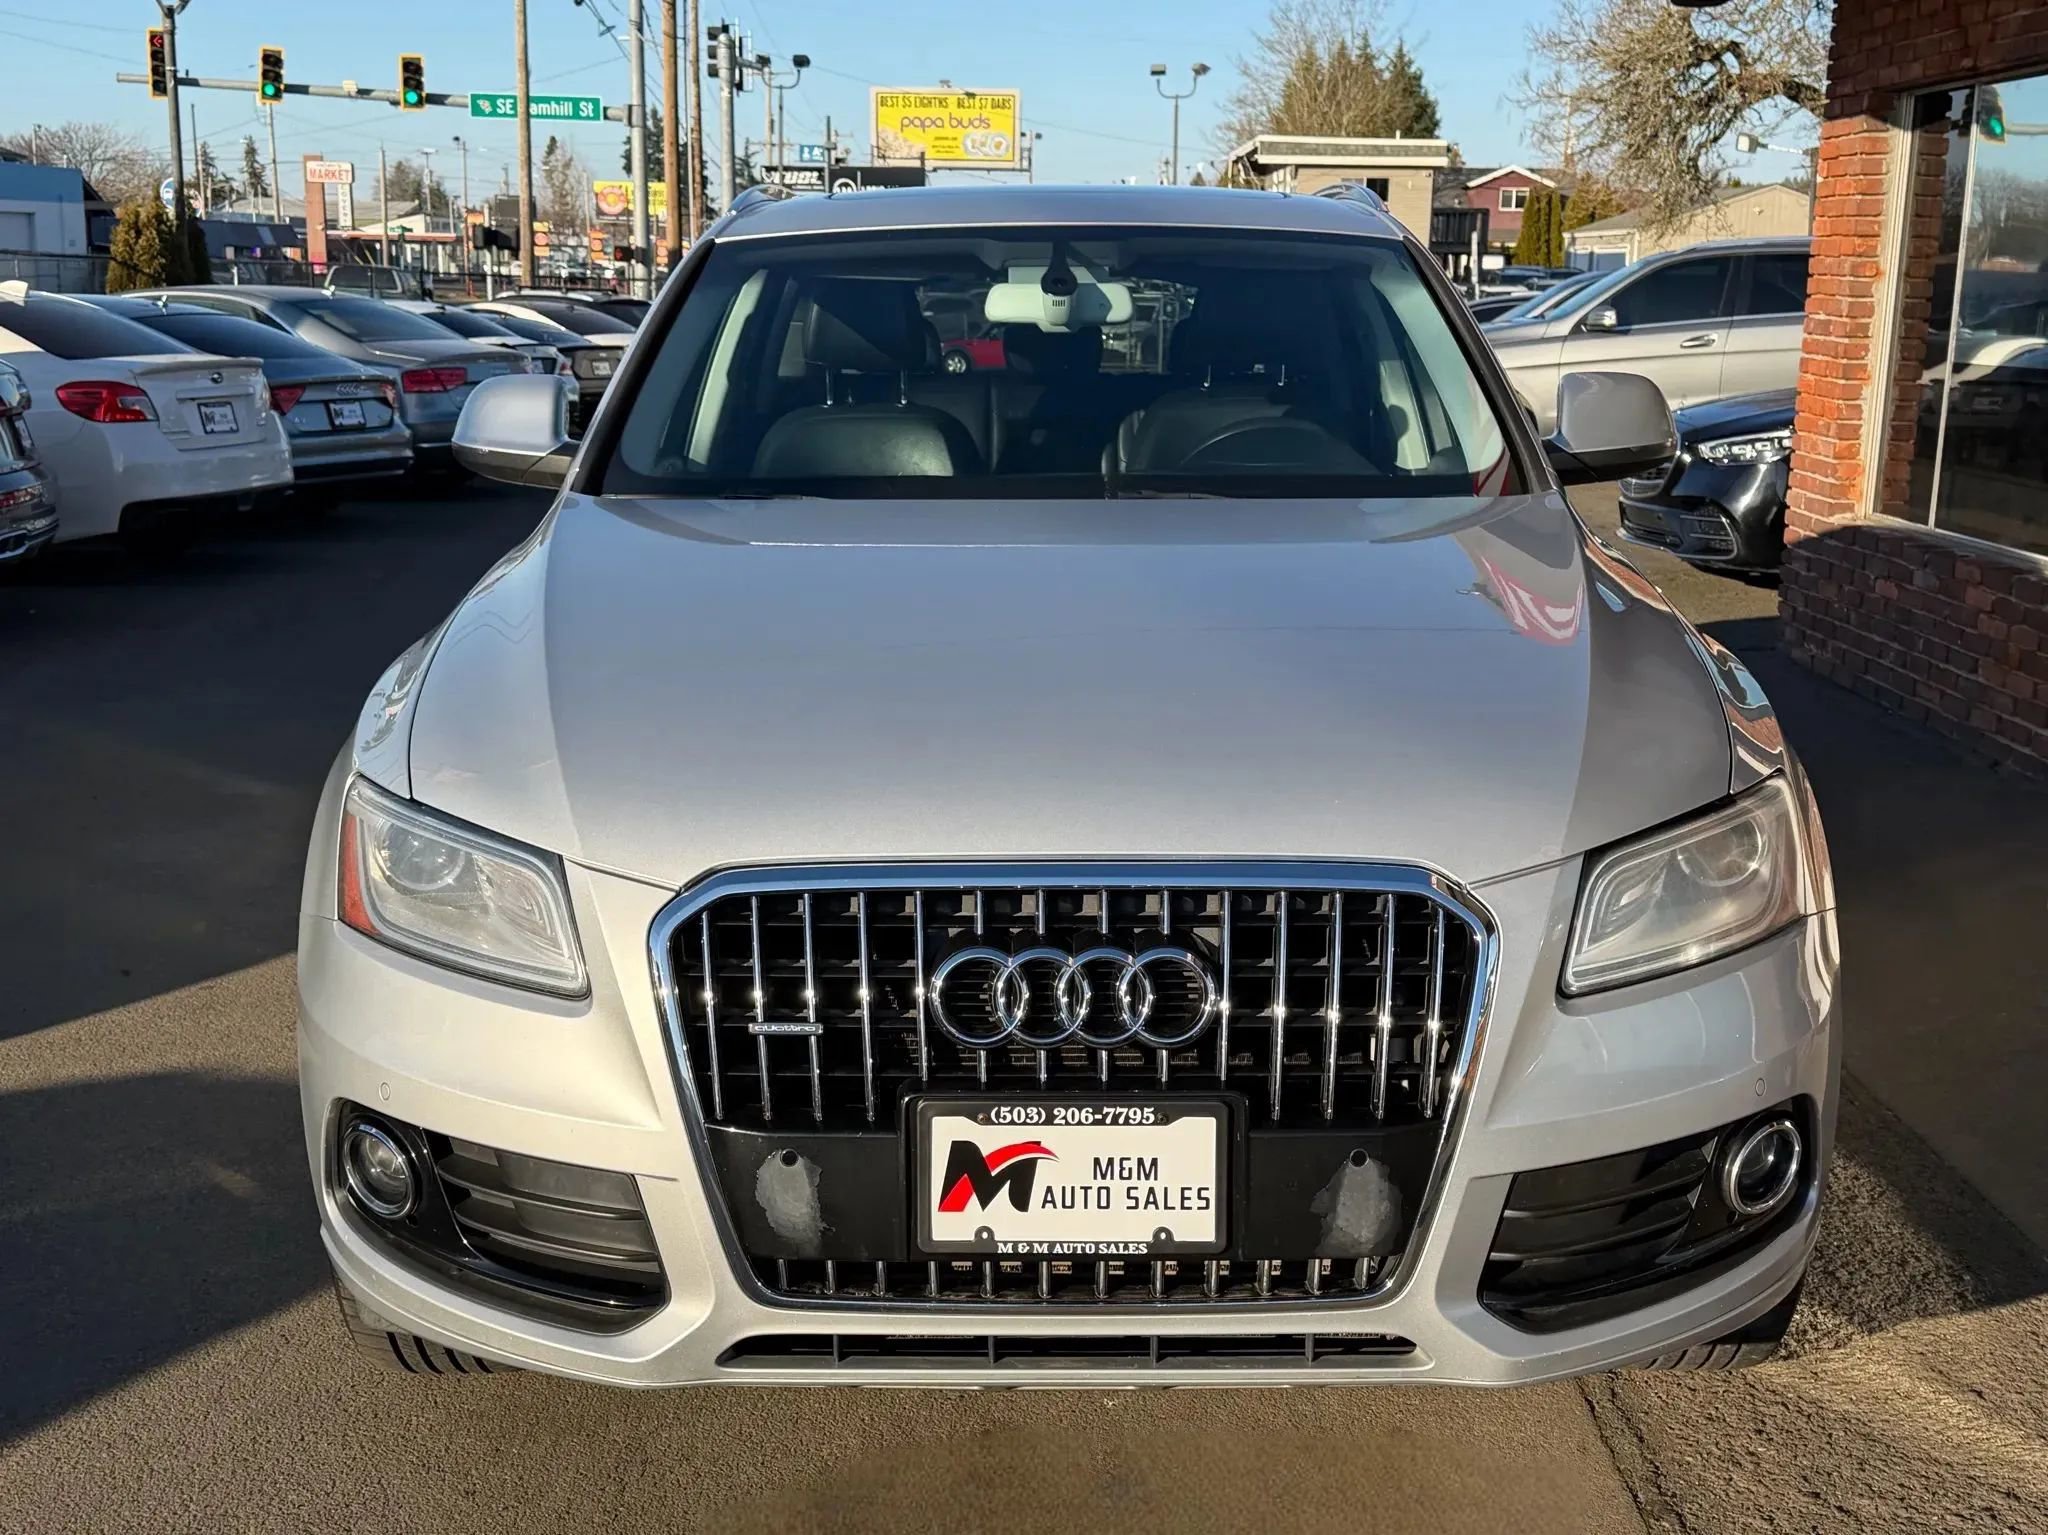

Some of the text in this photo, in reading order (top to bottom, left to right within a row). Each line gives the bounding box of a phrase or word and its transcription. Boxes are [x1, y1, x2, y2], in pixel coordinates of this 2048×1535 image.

[496, 98, 594, 117] SE amhill St
[880, 95, 899, 109] BEST
[957, 96, 976, 110] BEST
[900, 112, 991, 133] papa buds
[309, 168, 352, 181] MARKET
[755, 1024, 816, 1032] quattro
[990, 1106, 1155, 1125] (503) 206-7795
[1092, 1157, 1159, 1181] M&M
[1041, 1185, 1211, 1211] AUTO SALES
[997, 1242, 1148, 1255] M & M AUTO SALES
